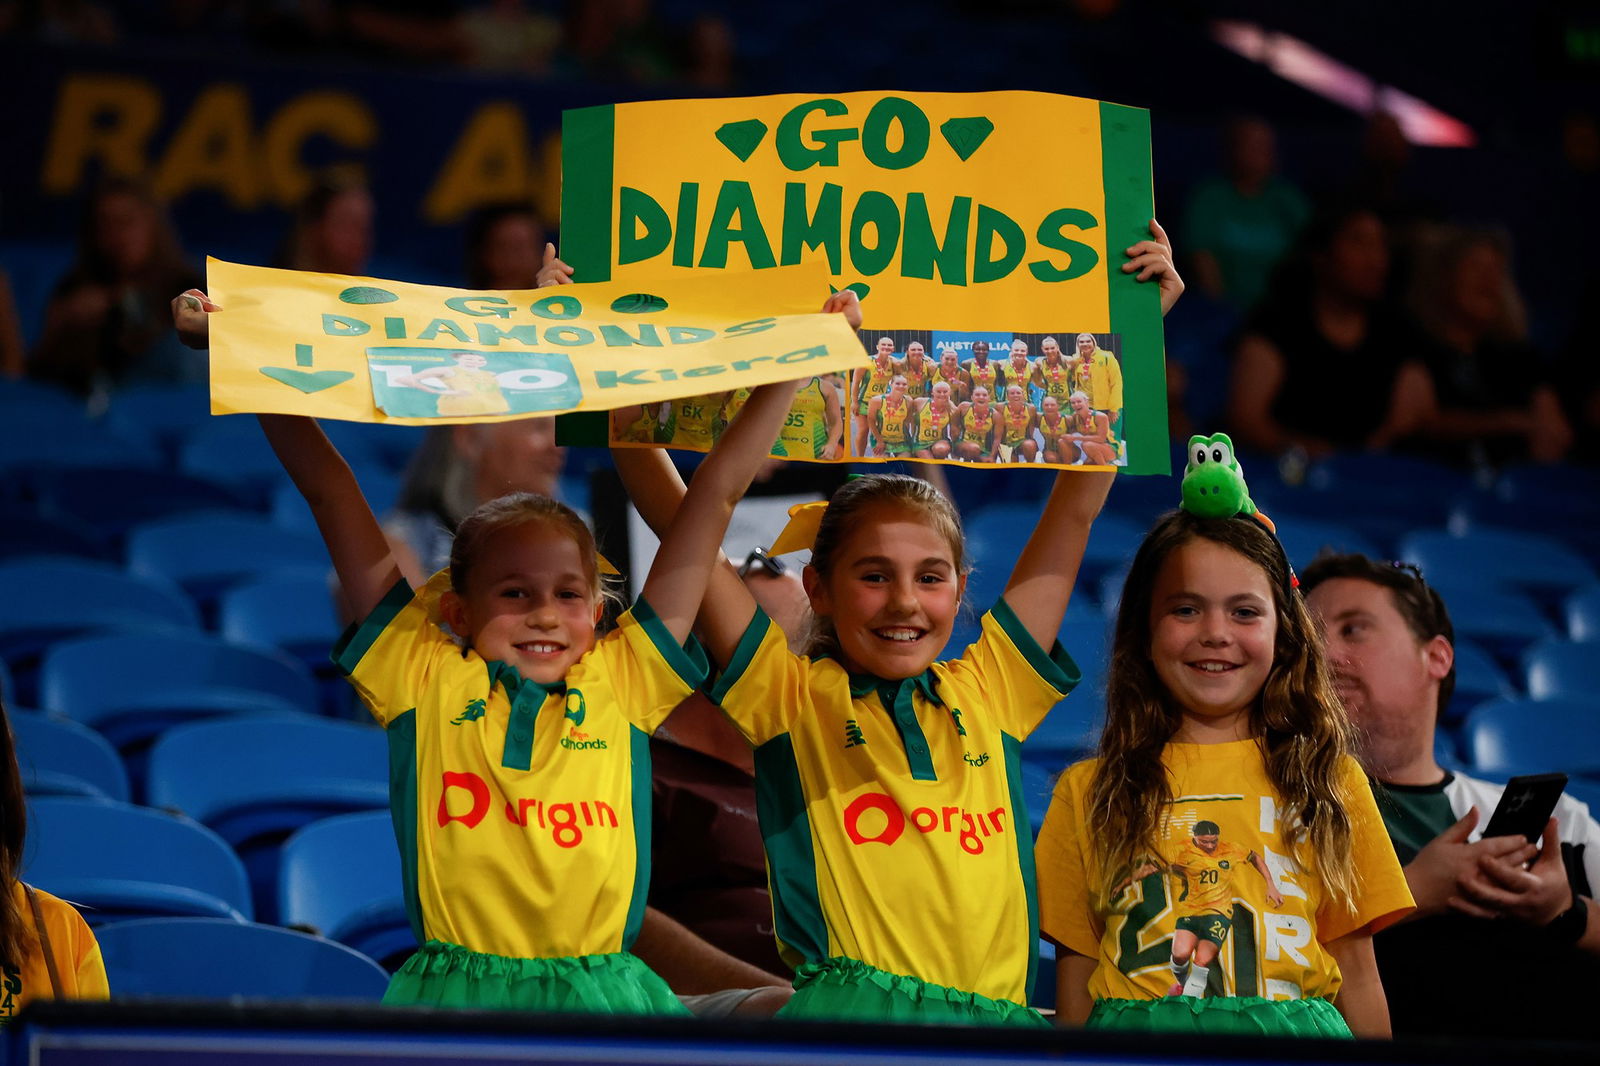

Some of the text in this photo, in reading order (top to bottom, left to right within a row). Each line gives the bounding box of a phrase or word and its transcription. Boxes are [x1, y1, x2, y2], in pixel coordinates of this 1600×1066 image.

[41, 73, 376, 210] RAC
[775, 97, 930, 171] GO
[618, 180, 1099, 286] DIAMONDS
[445, 295, 583, 320] GO
[322, 314, 777, 347] DIAMONDS
[594, 344, 829, 389] Kiera
[682, 405, 704, 419] GK
[1200, 870, 1218, 884] 20
[1209, 921, 1227, 940] 20
